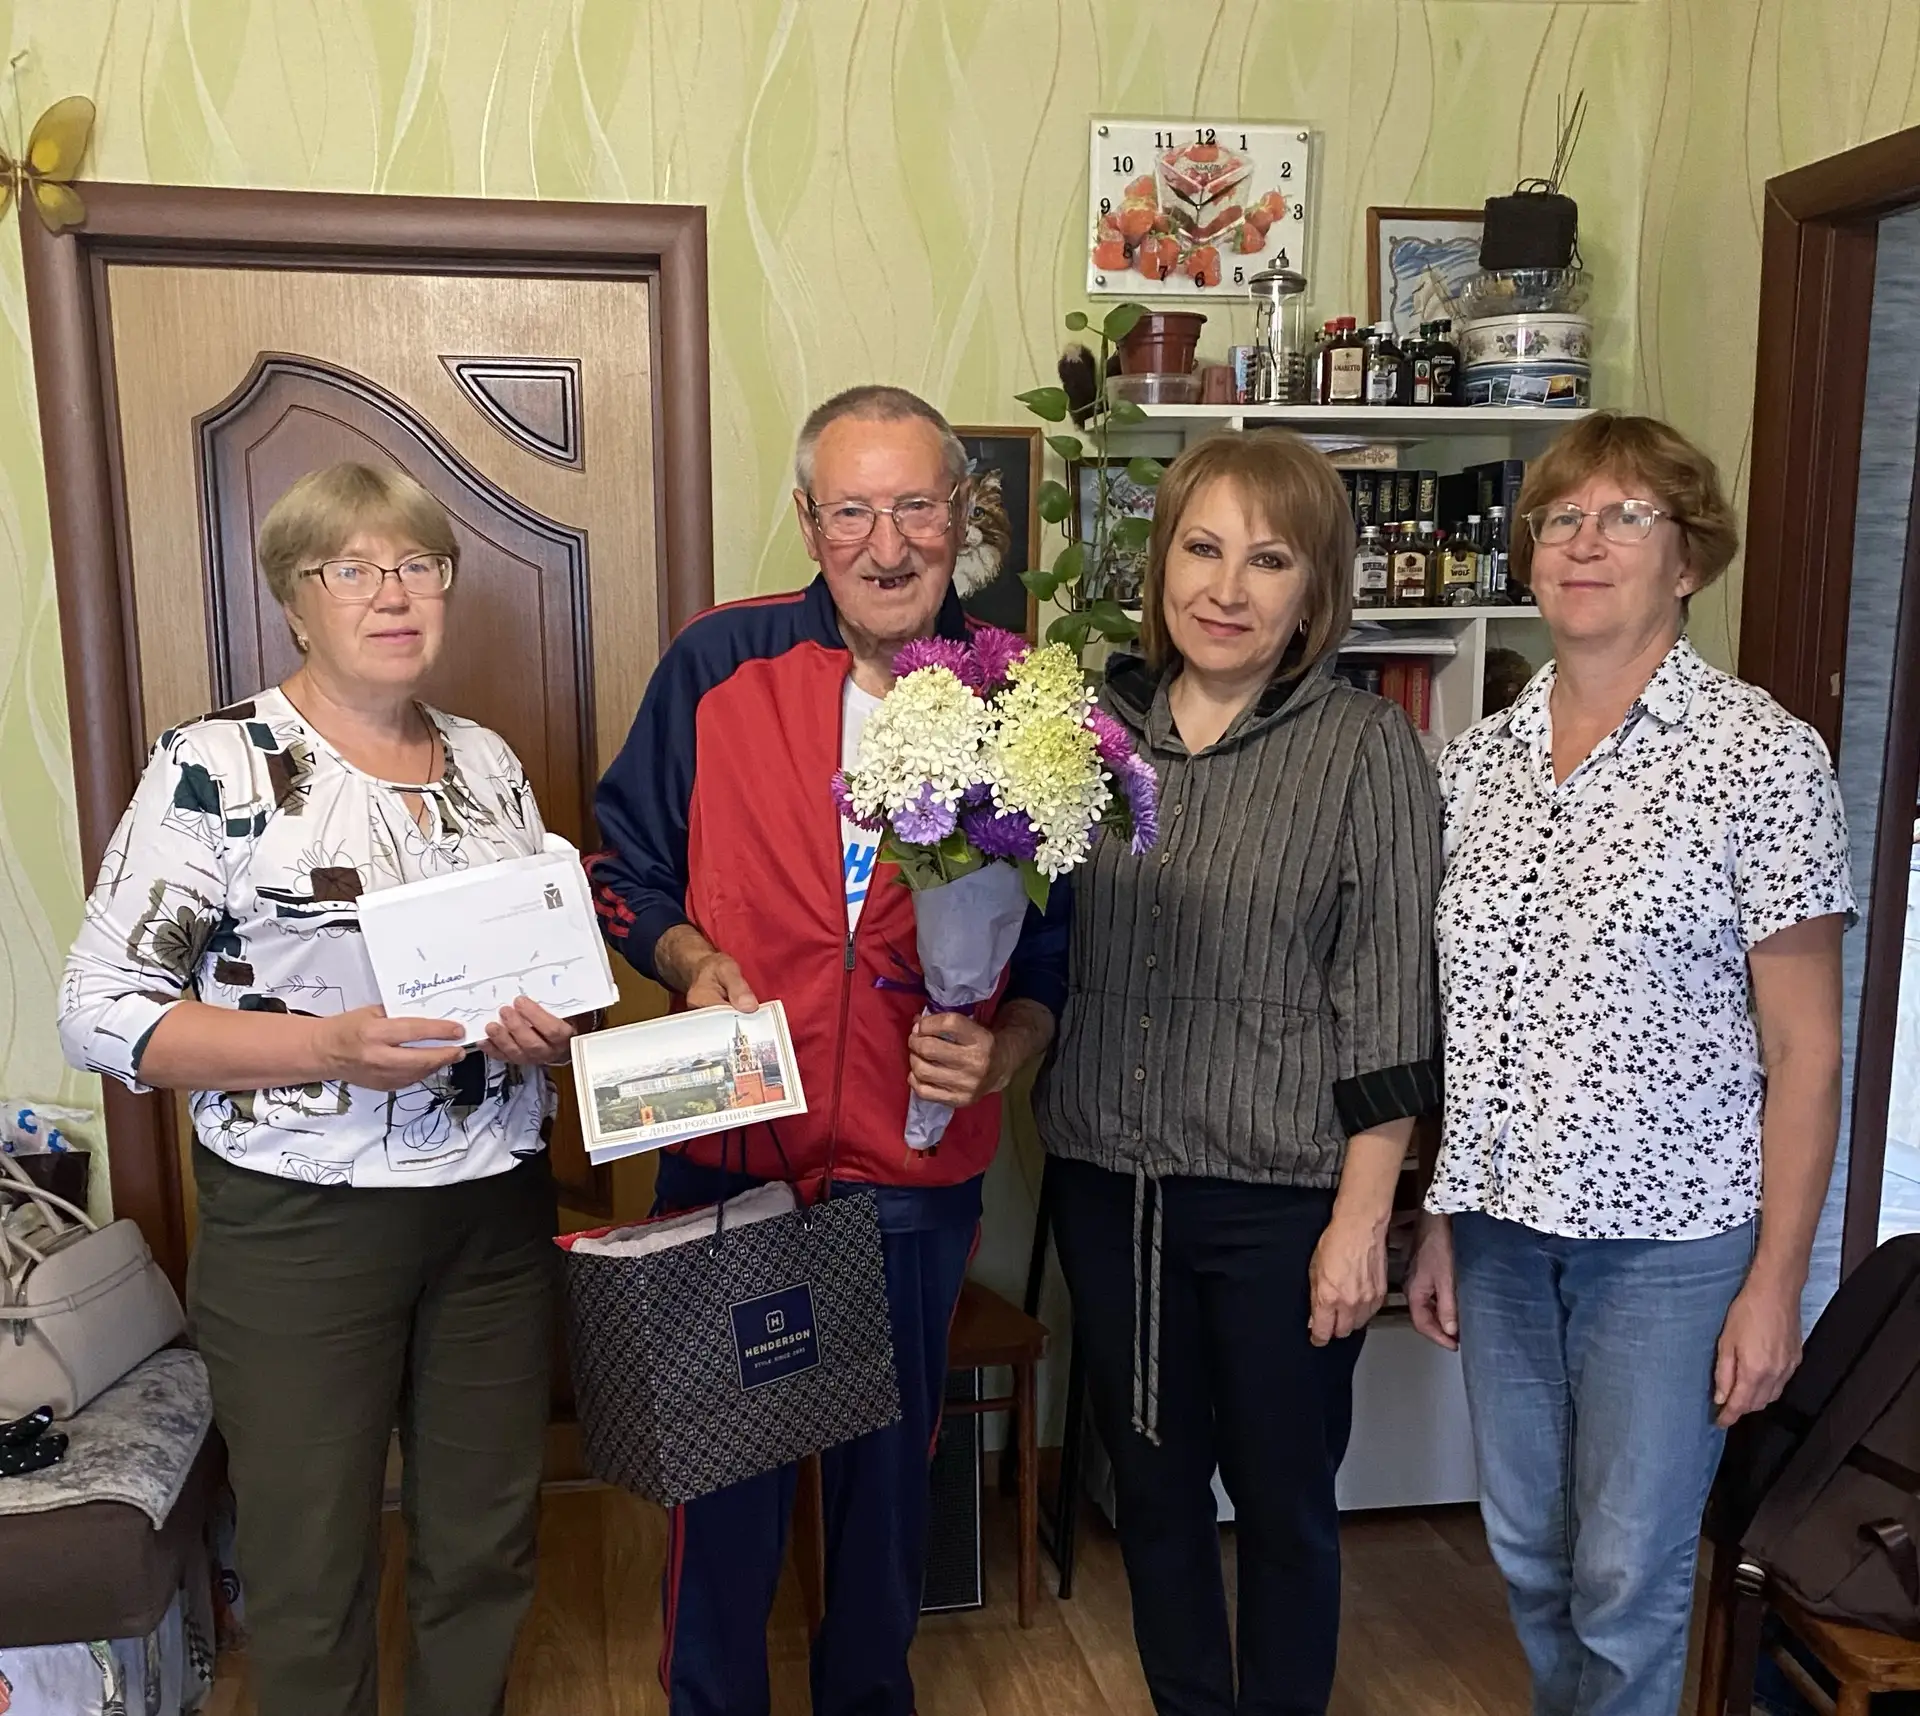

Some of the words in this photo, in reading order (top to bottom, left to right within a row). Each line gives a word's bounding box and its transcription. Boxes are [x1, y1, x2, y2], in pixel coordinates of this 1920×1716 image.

[1155, 132, 1174, 149] 11
[1195, 128, 1216, 146] 12
[1240, 134, 1248, 151] 1
[1113, 156, 1134, 173] 10
[1280, 162, 1291, 178] 2
[1100, 198, 1111, 215] 9
[1293, 204, 1304, 220] 3
[1158, 265, 1168, 281] 7
[1194, 271, 1205, 288] 6
[1233, 266, 1244, 283] 5
[397, 964, 466, 998] Поздравляю!
[639, 1129, 647, 1138] С
[684, 1109, 753, 1129] РОЖДЕНИЯ!
[744, 1328, 811, 1358] HENDERSON
